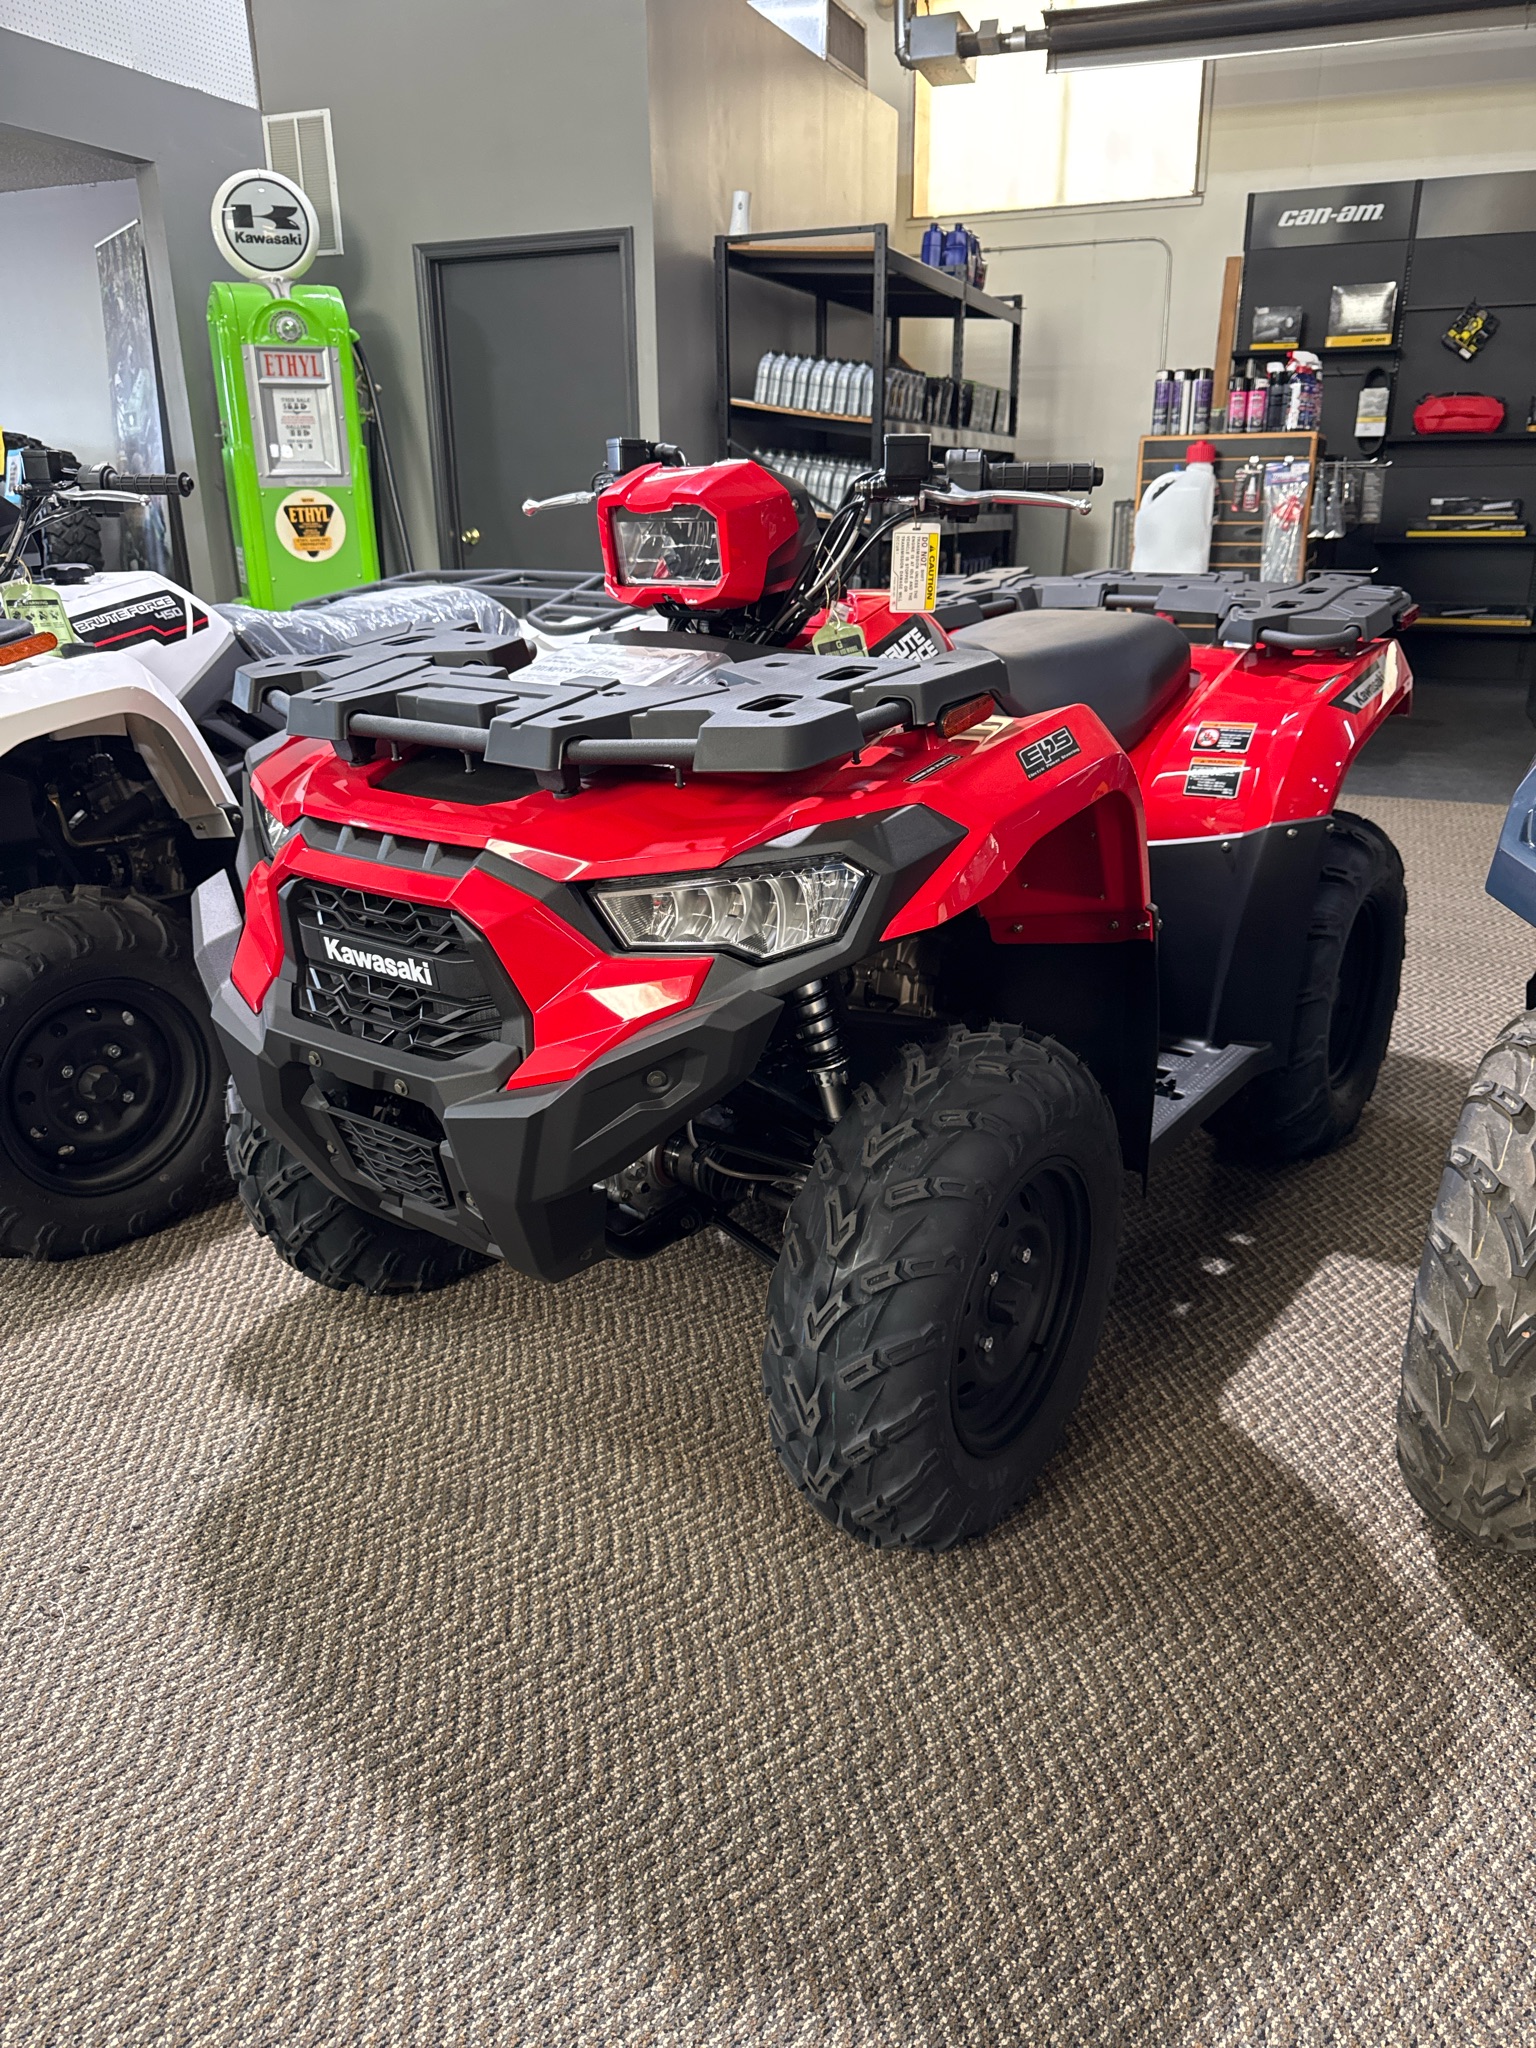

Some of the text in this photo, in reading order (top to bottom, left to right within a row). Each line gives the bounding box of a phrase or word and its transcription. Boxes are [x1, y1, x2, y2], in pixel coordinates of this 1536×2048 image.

[1278, 203, 1385, 227] can-am
[235, 231, 302, 245] Kawasaki
[264, 353, 322, 377] ETHYL
[288, 506, 331, 523] ETHYL
[922, 536, 928, 548] DO
[926, 555, 936, 600] CAUTION
[154, 607, 184, 621] 450
[836, 640, 844, 649] G
[1019, 727, 1073, 769] EPS
[323, 936, 433, 986] Kawasaki
